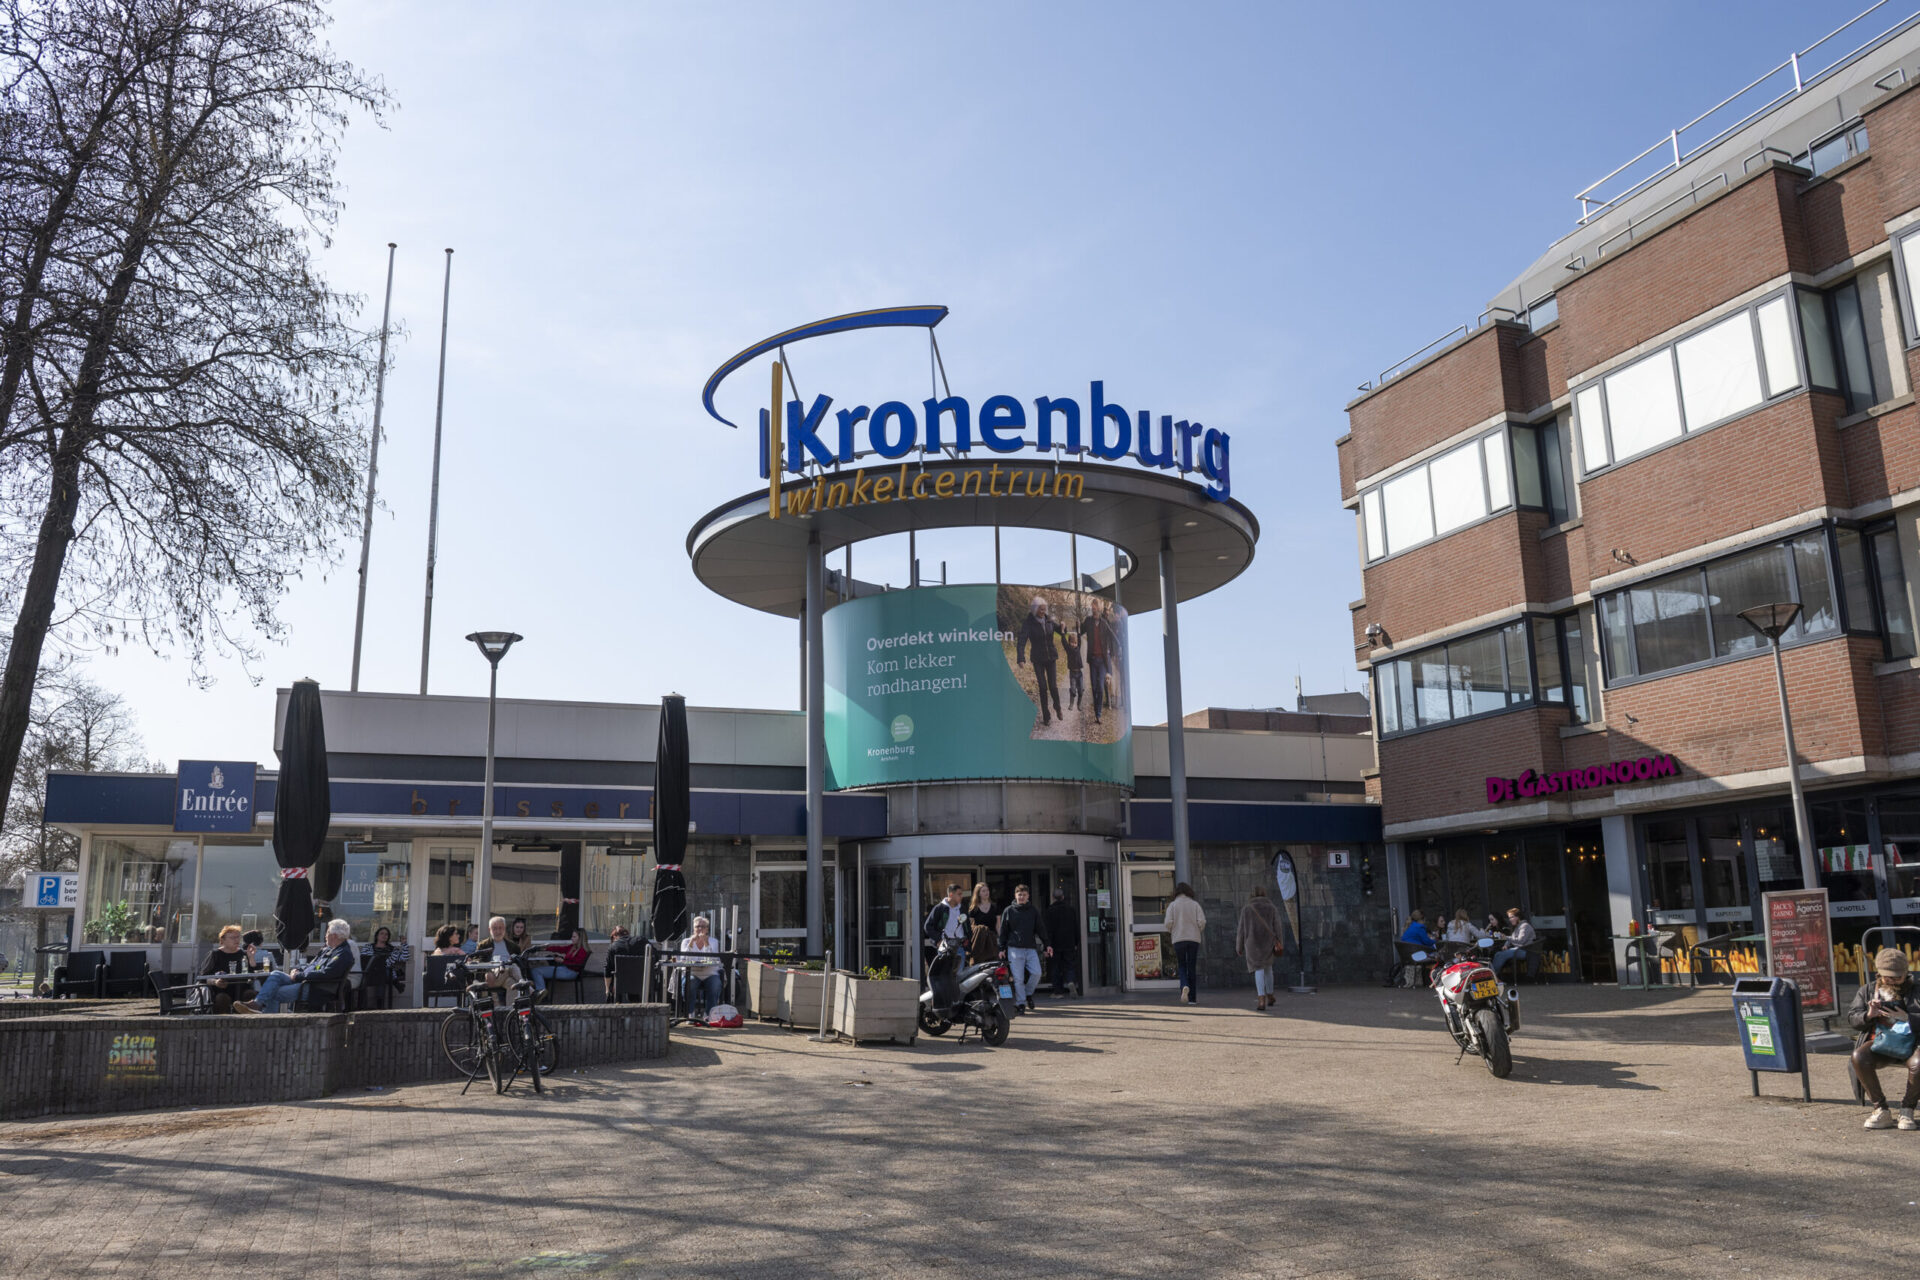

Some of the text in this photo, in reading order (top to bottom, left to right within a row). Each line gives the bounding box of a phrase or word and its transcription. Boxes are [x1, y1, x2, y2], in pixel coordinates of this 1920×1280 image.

[787, 380, 1231, 500] Kronenburg
[787, 463, 1085, 515] winkelcentrum
[867, 628, 1015, 651] Overdekt winkelen
[867, 653, 956, 675] Kom lekker
[867, 673, 967, 697] rondhangen!
[867, 745, 915, 757] Kronenburg
[181, 788, 248, 812] Entrée
[1335, 853, 1342, 865] B
[43, 878, 56, 894] P
[1796, 904, 1823, 915] Agenda
[112, 1033, 155, 1049] stem
[109, 1049, 157, 1065] DENK
